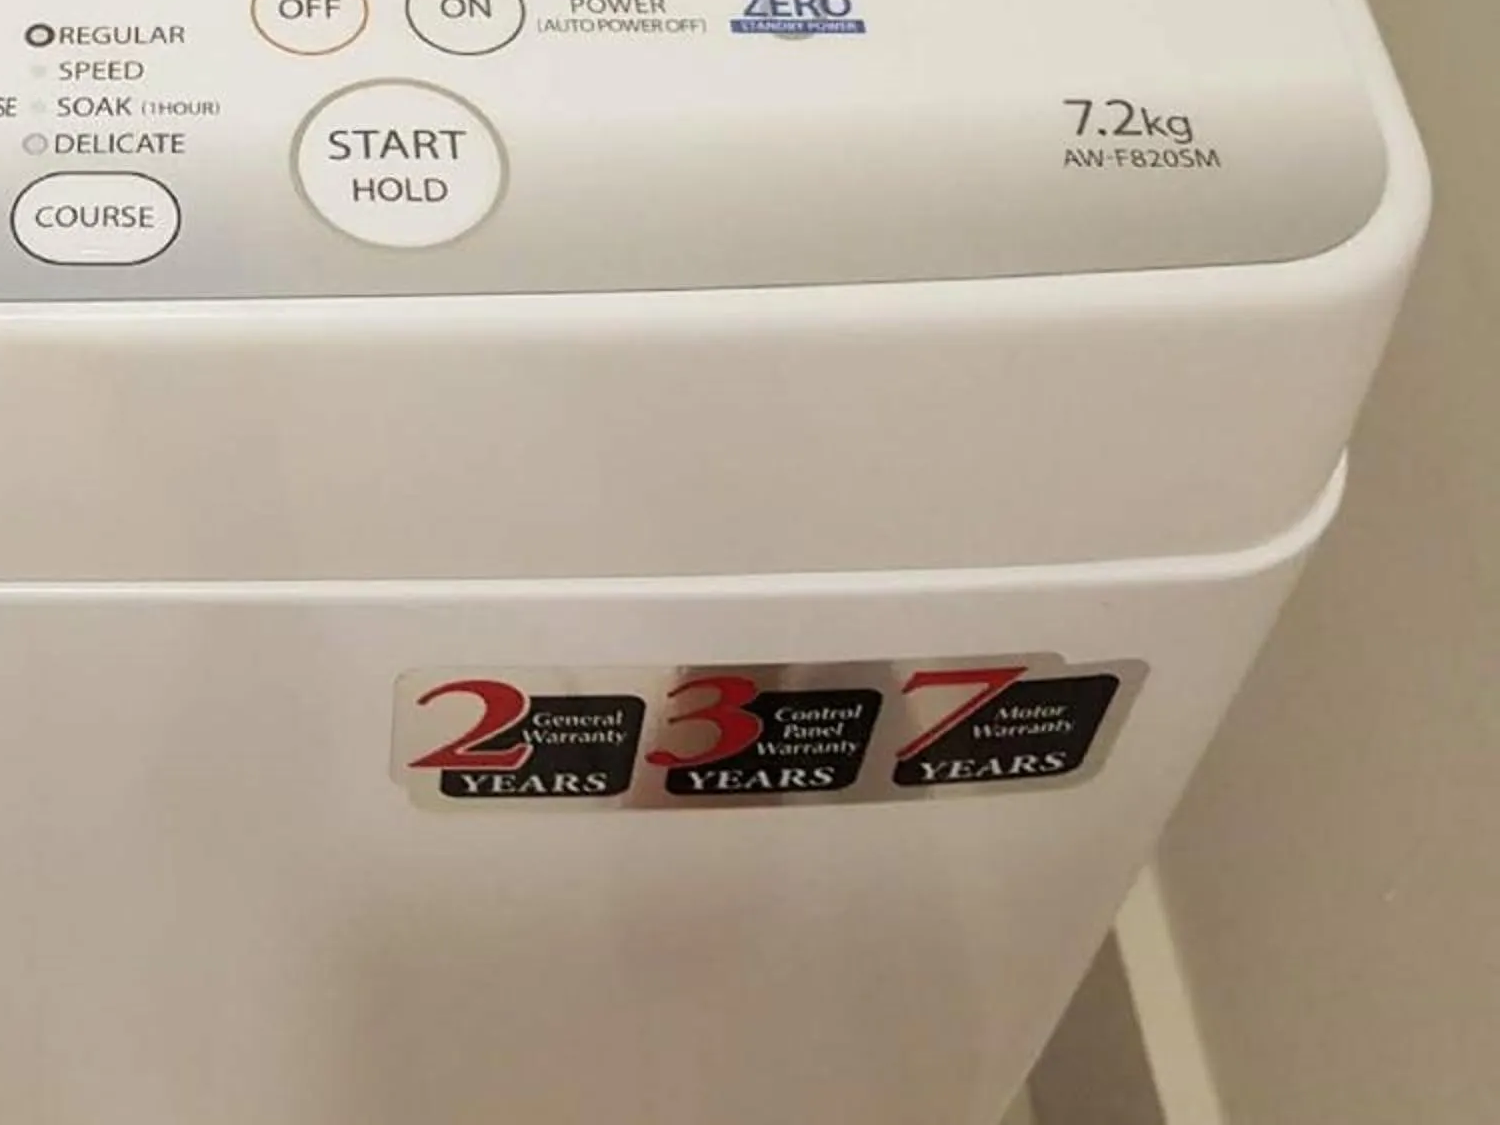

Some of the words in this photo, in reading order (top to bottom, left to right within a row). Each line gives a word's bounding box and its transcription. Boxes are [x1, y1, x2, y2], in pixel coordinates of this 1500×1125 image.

[58, 26, 186, 46] REGULAR
[537, 18, 594, 33] (AUTO
[597, 18, 664, 33] POWER
[665, 18, 707, 33] OFF)
[741, 19, 803, 33] STANDBY
[806, 19, 858, 33] POWER
[58, 61, 146, 81] SPEED
[56, 97, 133, 117] SOAK
[1063, 98, 1194, 144] 7.2kg
[54, 134, 187, 155] DELICATE
[327, 129, 467, 161] START
[1063, 148, 1222, 169] AW-F820SM
[351, 177, 449, 203] HOLD
[34, 205, 156, 229] COURSE
[531, 710, 623, 727] General
[645, 676, 763, 767] 3
[774, 703, 863, 722] Control
[895, 666, 1028, 760] 7
[995, 704, 1069, 721] Motor
[406, 679, 527, 768] 2
[782, 722, 845, 740] Panel
[973, 719, 1074, 740] Warranty
[522, 729, 627, 745] Warranty
[756, 739, 860, 756] Warranty
[918, 751, 1068, 781] YEARS
[459, 772, 608, 793] YEARS
[687, 766, 836, 791] YEARS
